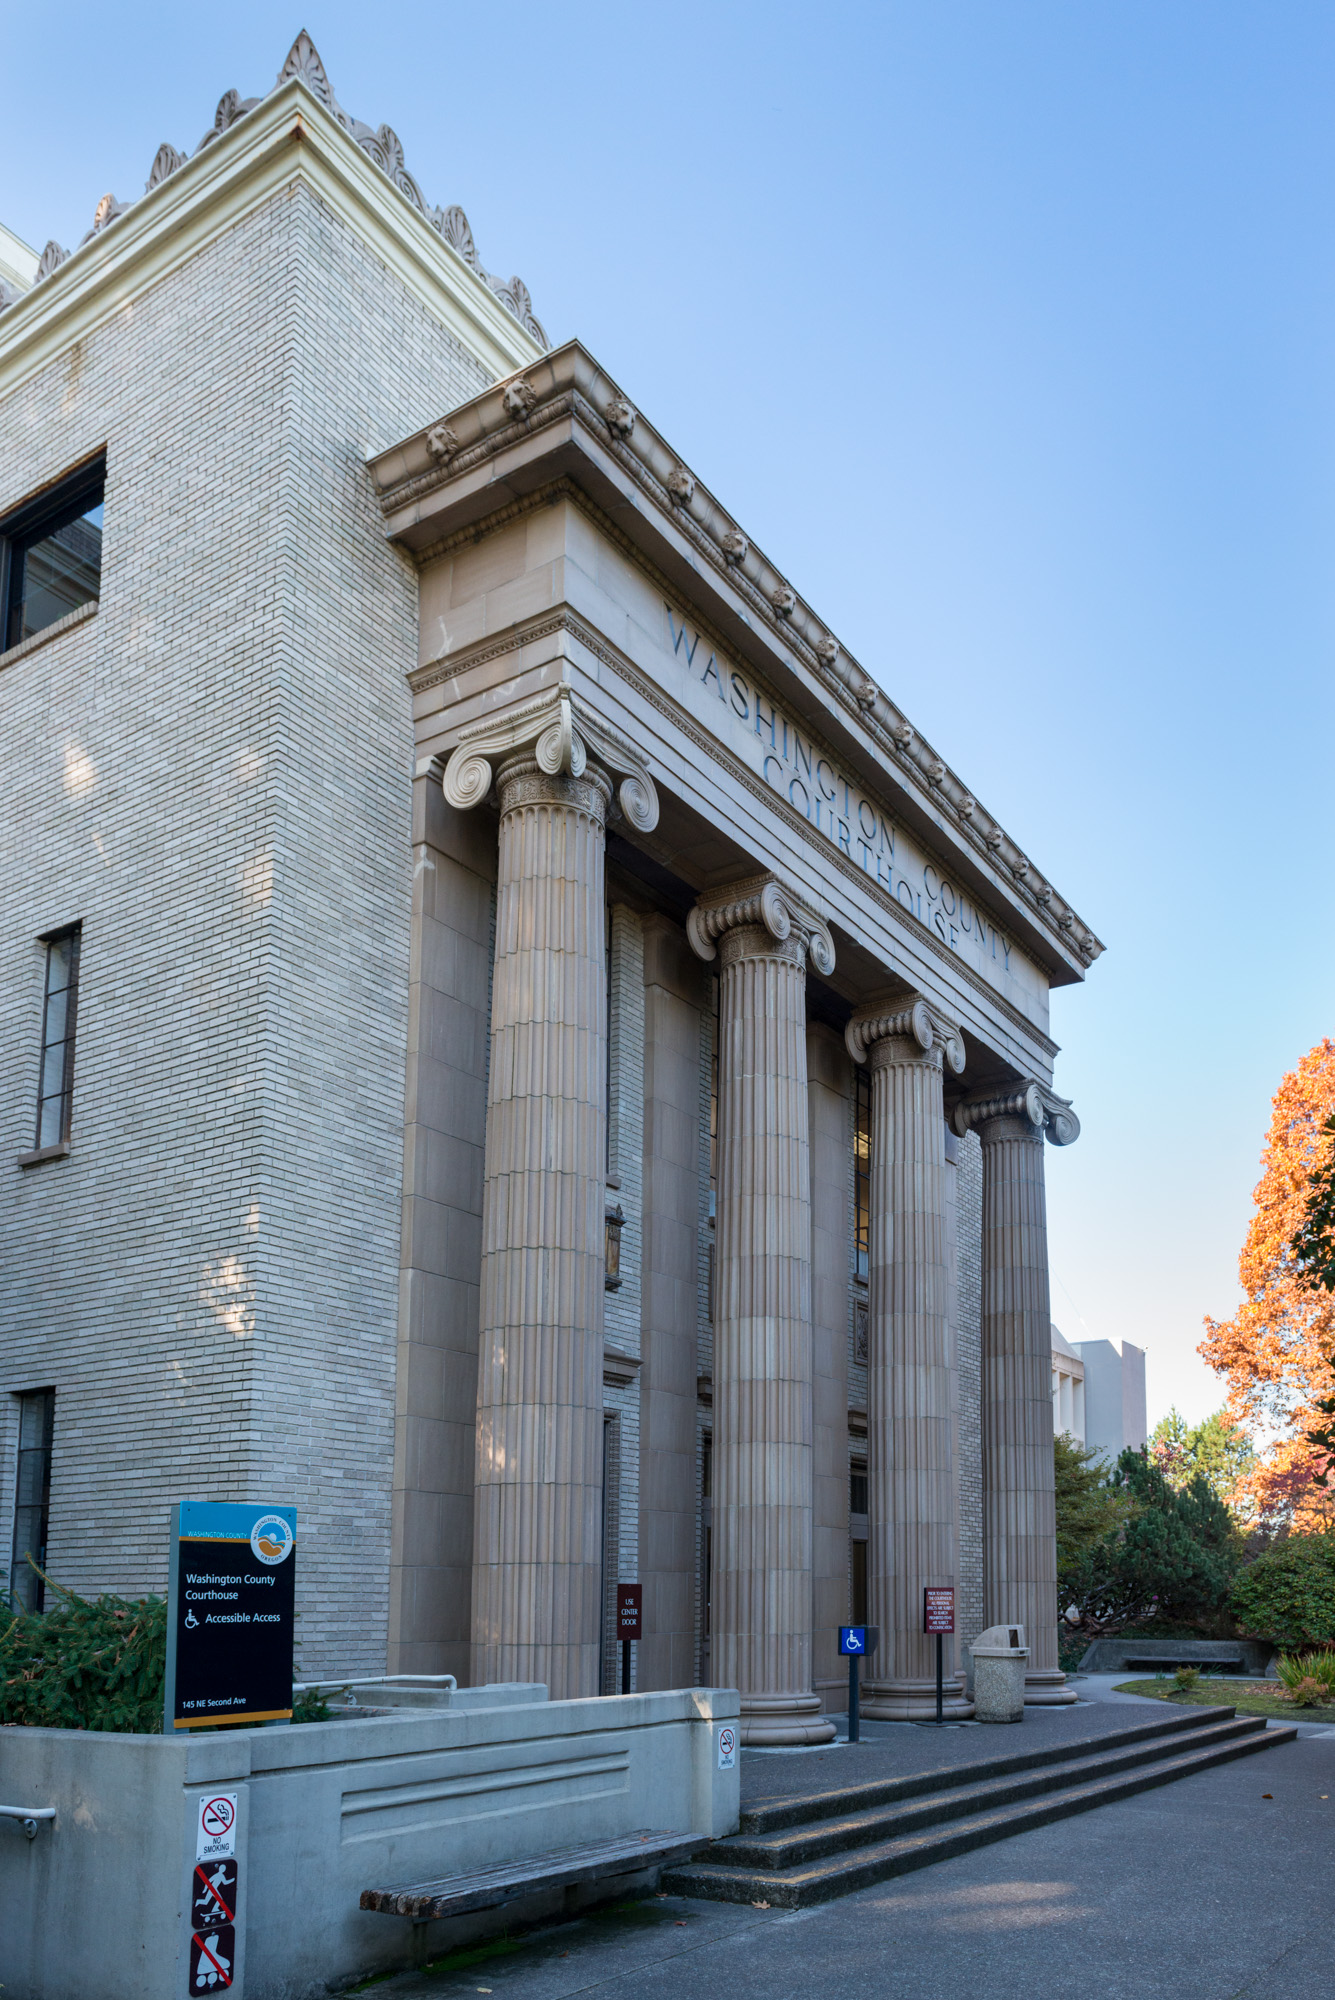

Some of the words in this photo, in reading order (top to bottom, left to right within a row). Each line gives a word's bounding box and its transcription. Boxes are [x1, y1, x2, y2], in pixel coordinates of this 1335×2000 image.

[664, 601, 896, 861] WASHINGTON
[923, 864, 1012, 971] COUNTY
[763, 755, 959, 950] COURTHOUSE
[187, 1530, 225, 1538] WASHINGTON
[186, 1573, 242, 1586] Washington
[243, 1574, 276, 1586] County
[185, 1590, 239, 1600] Courthouse
[205, 1612, 251, 1623] Accessible
[252, 1612, 281, 1622] Access
[182, 1700, 195, 1709] 145
[196, 1700, 206, 1708] NE
[207, 1697, 232, 1706] Second
[233, 1697, 247, 1705] Ave
[213, 1836, 221, 1845] NO
[203, 1843, 230, 1854] SMOKING
